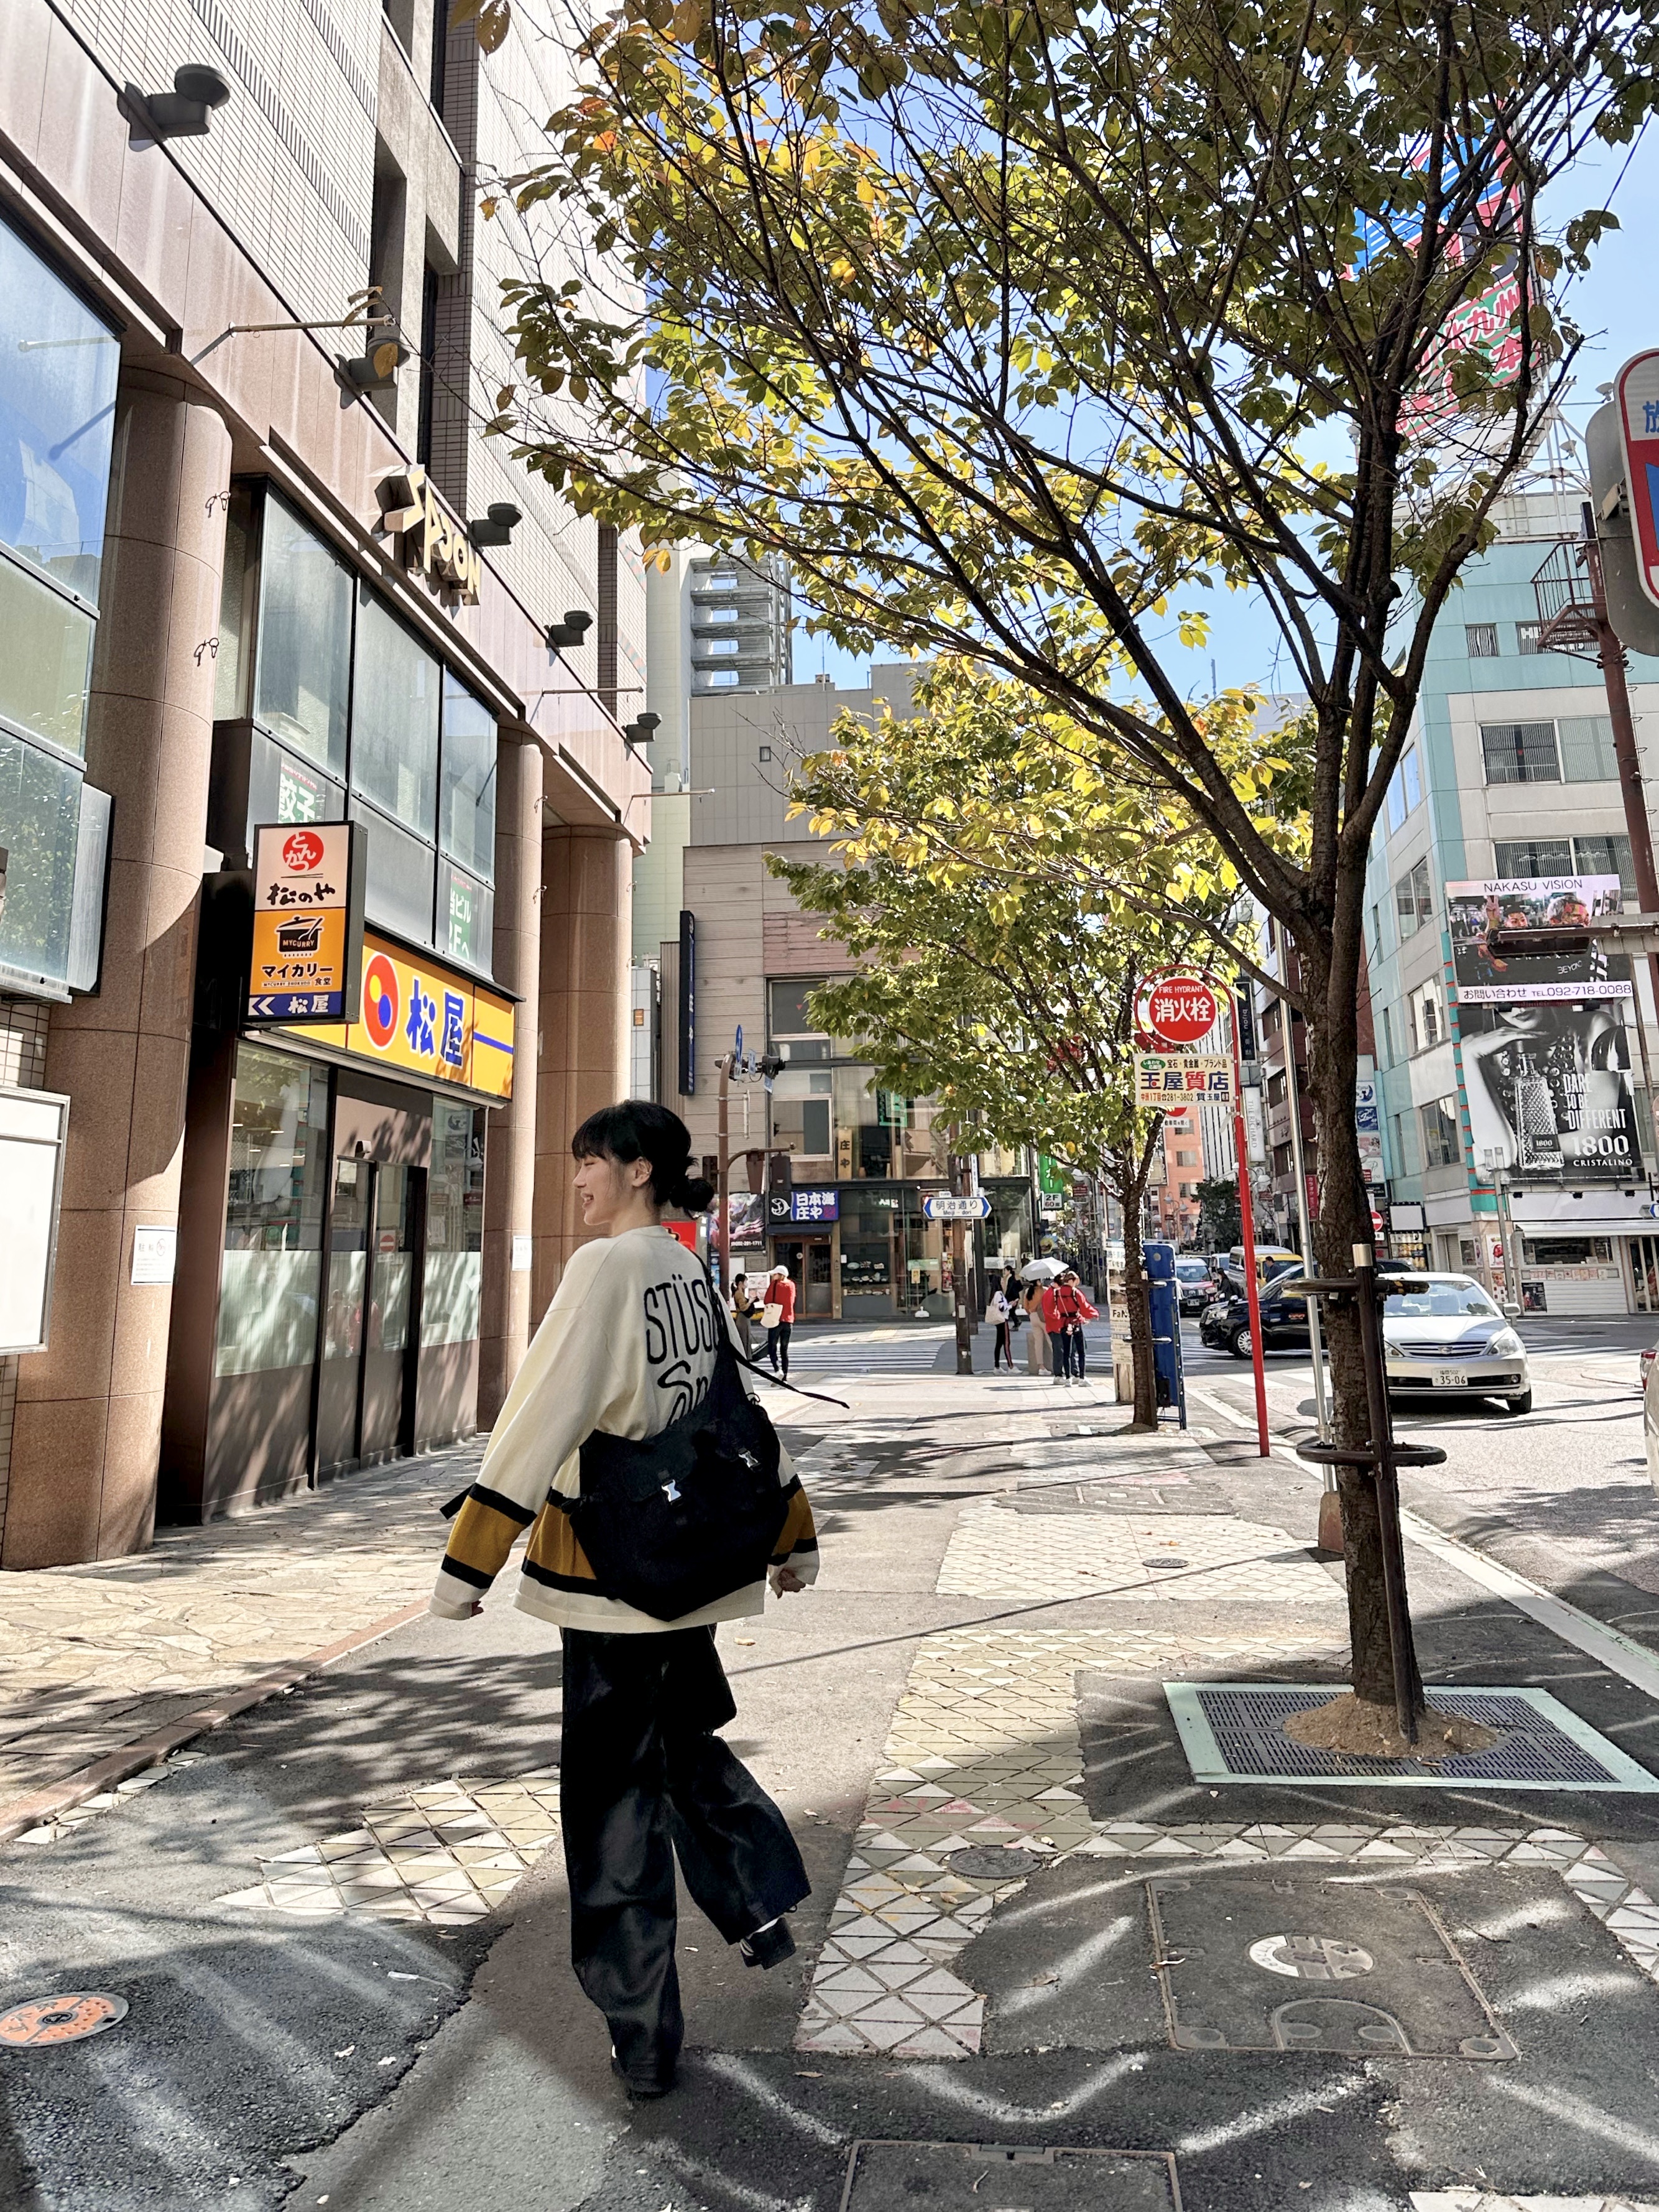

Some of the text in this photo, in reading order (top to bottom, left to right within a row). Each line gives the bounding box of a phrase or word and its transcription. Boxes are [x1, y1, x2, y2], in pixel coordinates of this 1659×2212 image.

[285, 832, 317, 871] とんかつ
[266, 882, 336, 905] 松のや
[1484, 879, 1583, 893] NAKASU VISION
[282, 939, 315, 948] MYCURRY
[262, 963, 333, 979] マイカリー
[315, 977, 331, 986] 食堂
[1175, 985, 1203, 993] HYDRANT
[1463, 988, 1527, 1000] お問い合わせ
[1547, 984, 1632, 996] 092-718-0088
[287, 995, 330, 1014] 松屋
[1154, 996, 1211, 1023] 消火栓
[404, 976, 465, 1069] 松屋
[1140, 1071, 1229, 1091] 玉屋質店
[1563, 1073, 1592, 1093] DARE
[1566, 1093, 1590, 1109] TO BE
[1568, 1109, 1626, 1130] DIFFERENT
[1249, 1116, 1257, 1148] RICHARD
[1572, 1135, 1630, 1157] 1800
[1573, 1159, 1633, 1167] CRISTALINO
[796, 1192, 836, 1206] 日本海
[936, 1200, 977, 1210] 明治通り
[796, 1206, 823, 1220] 庄や
[644, 1274, 719, 1364] STÜS
[1440, 1376, 1466, 1384] 35-06
